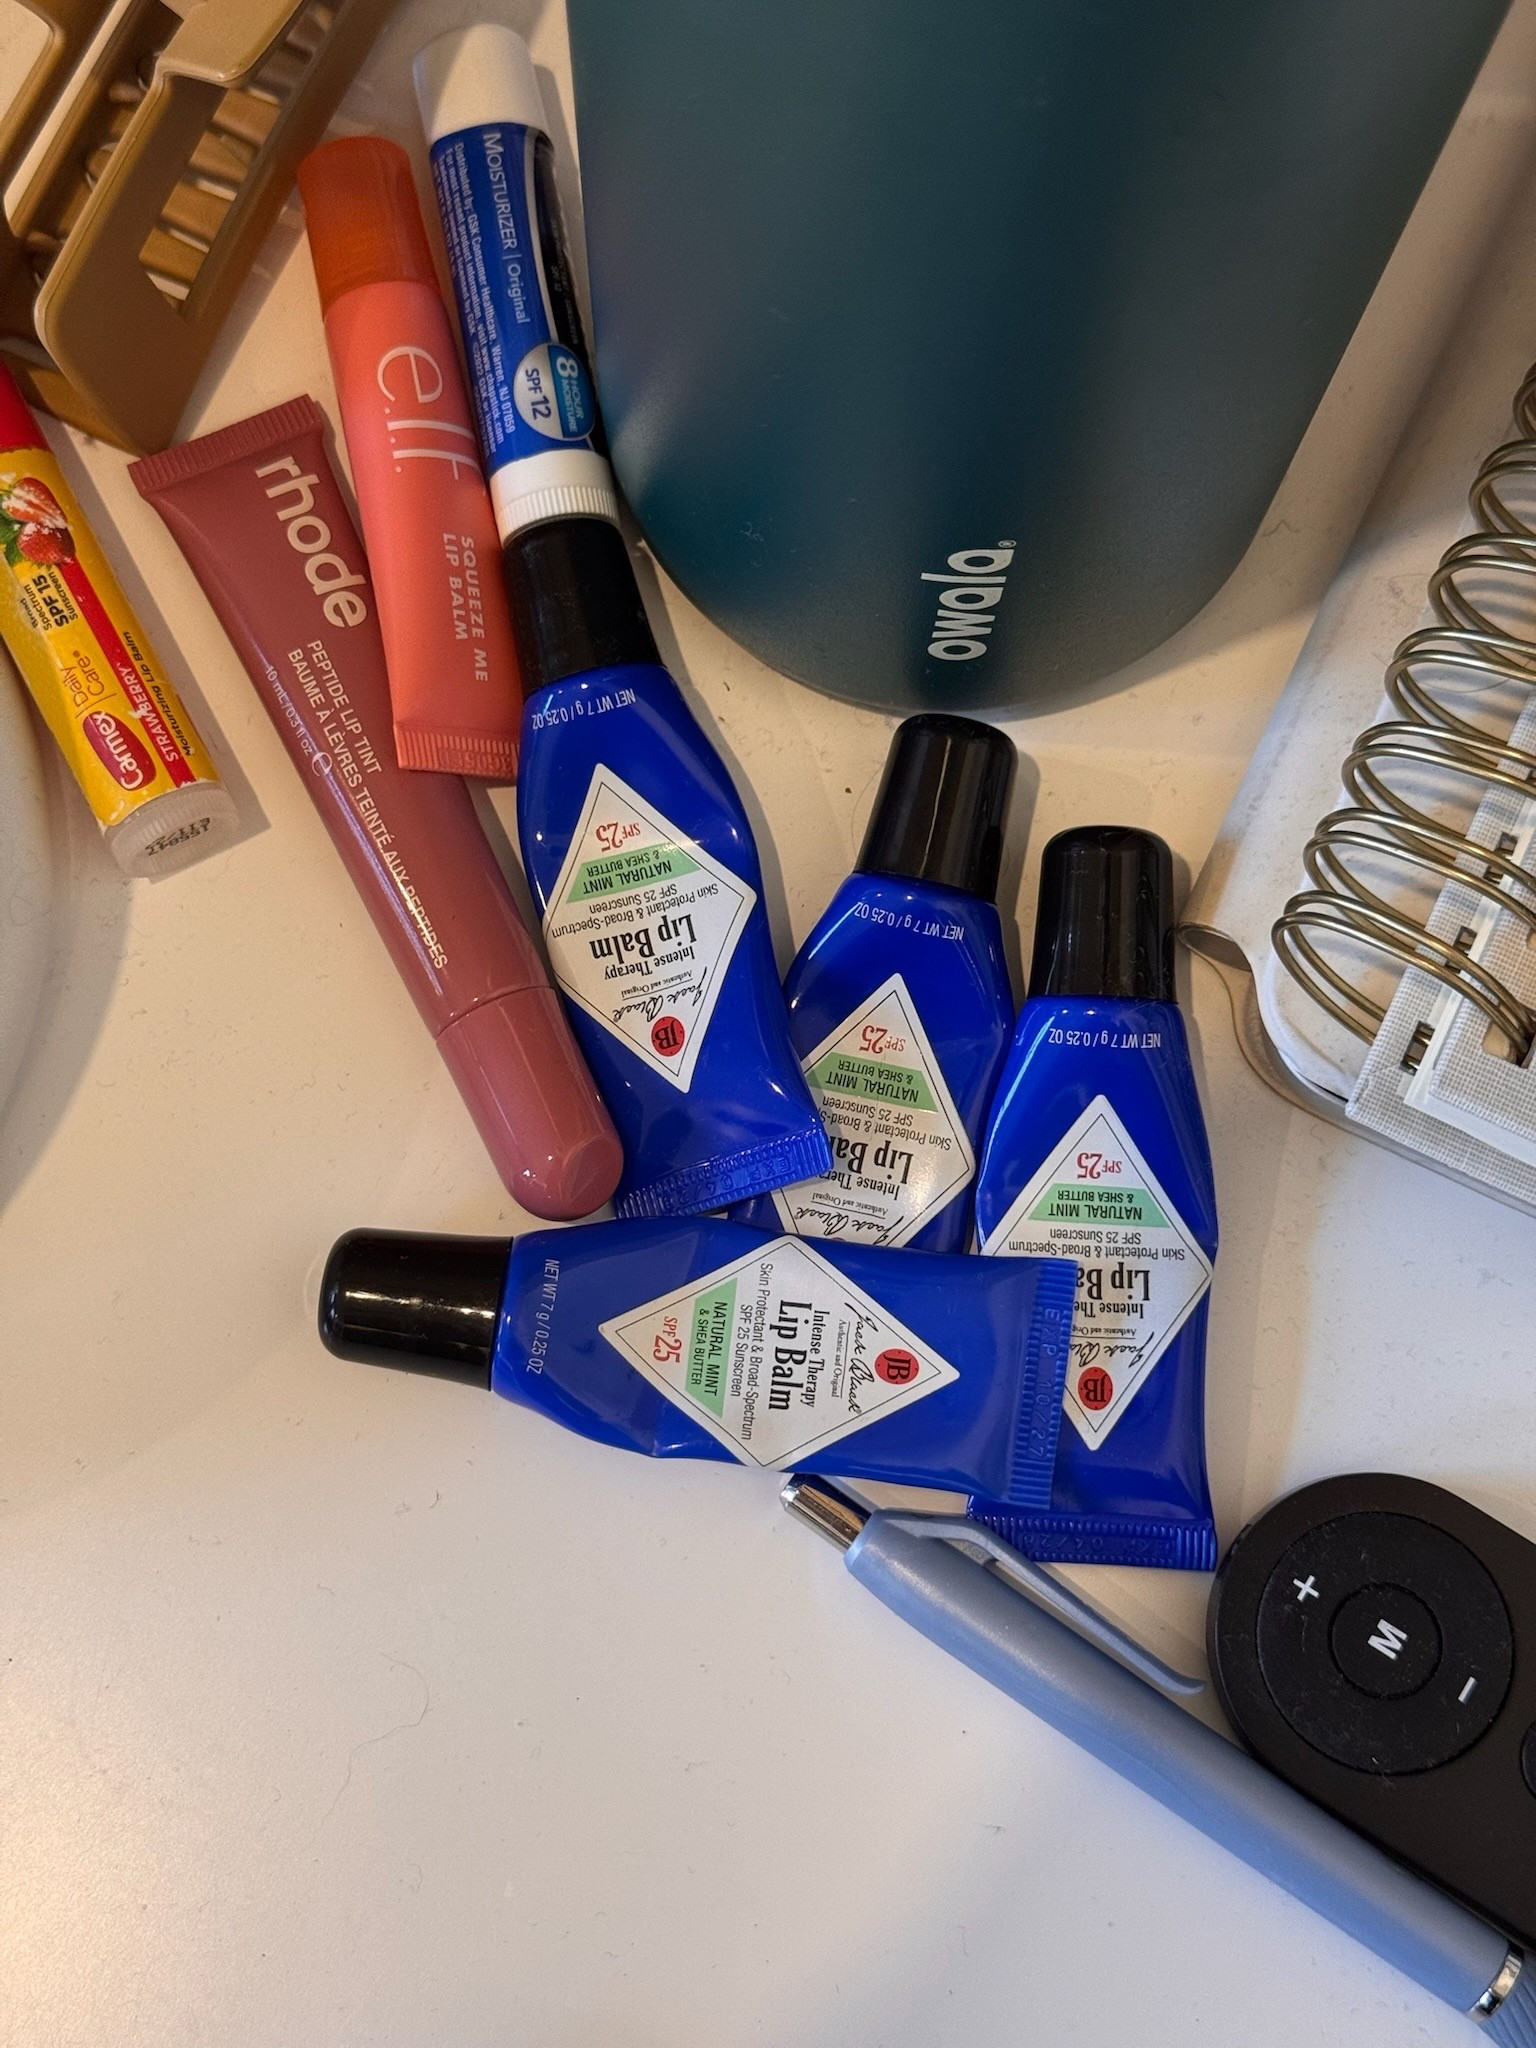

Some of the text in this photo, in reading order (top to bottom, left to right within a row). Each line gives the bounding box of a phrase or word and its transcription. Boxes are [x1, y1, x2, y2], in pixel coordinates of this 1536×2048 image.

[457, 225, 472, 261] product
[503, 263, 530, 324] Original
[466, 213, 516, 434] GSK Consumer NJ 07059
[476, 324, 487, 346] visit
[479, 347, 506, 444] www.chapstick.com
[525, 367, 552, 420] SPF 12
[555, 354, 578, 379] 8
[570, 379, 584, 420] HOUR
[377, 345, 487, 496] e.l.f.
[560, 378, 576, 433] MOISTURE
[255, 455, 369, 629] rhode
[31, 572, 70, 628] SPF 15
[46, 570, 79, 621] Sunscreen
[443, 531, 467, 640] LIP BALM
[21, 583, 53, 630] Spectrum
[461, 534, 488, 682] SQUEEZE ME
[60, 665, 92, 709] Daily
[121, 629, 193, 758] Moisturizing Lip Balm
[594, 694, 613, 713] WT
[613, 687, 636, 707] NET
[117, 661, 179, 765] STRAWBERRY
[305, 639, 381, 777] PEPTIDE LIP TINT
[530, 713, 544, 729] OZ
[586, 700, 594, 715] 7
[93, 709, 144, 791] Carmex
[286, 648, 449, 969] BAUME À LÈVRES TEINTÉ AUX PEPTIDES
[581, 860, 672, 894] NATURAL MINT
[586, 852, 650, 877] SHEA BUTTER
[550, 882, 718, 939] Skin Protectant & Broad-Spectrum
[588, 883, 677, 915] SPF 25 Sunscreen
[853, 901, 870, 918] OZ
[588, 909, 696, 969] Lip Balm
[912, 919, 920, 932] 7
[922, 921, 941, 936] WT
[941, 923, 964, 941] NET
[602, 945, 695, 984] Intense Therapy
[619, 969, 693, 998] Authentic and Original
[1048, 1028, 1063, 1043] OZ
[1111, 1033, 1117, 1046] 7
[1120, 1034, 1138, 1047] WT
[1140, 1032, 1160, 1048] NET
[825, 1070, 919, 1102] NATURAL MINT
[837, 1058, 913, 1084] & SHEA BUTTER
[821, 1094, 913, 1125] SPF 25 Sunscreen
[862, 1119, 951, 1150] Skin Protectant &
[869, 1138, 915, 1184] Lip
[812, 1191, 888, 1216] Authentic and Original
[854, 1175, 900, 1200] Intense
[1057, 1189, 1133, 1202] & SHEA BUTTER
[1048, 1202, 1141, 1219] NATURAL MINT
[1008, 1238, 1184, 1259] Skin Protectant & Broad-Spectrum
[1049, 1228, 1140, 1243] SPF 25 Sunscreen
[543, 1258, 559, 1281] NET
[1110, 1261, 1150, 1300] Lip
[539, 1302, 553, 1310] 7
[541, 1282, 557, 1301] WT
[1099, 1301, 1143, 1318] Intense
[689, 1308, 710, 1385] & SHEA BUTTER
[1089, 1326, 1136, 1334] Authentic and
[526, 1357, 543, 1374] OZ
[702, 1301, 728, 1396] NATURAL MINT
[728, 1304, 753, 1397] SPF 25 Sunscreen
[738, 1262, 773, 1440] Skin Protectant & Broad-Spectrum
[766, 1298, 812, 1413] Lip Balm
[799, 1309, 829, 1408] Intense Therapy
[829, 1319, 848, 1398] Authentic and Original
[1029, 1308, 1060, 1457] EXP 10/27
[1367, 1618, 1409, 1661] M
